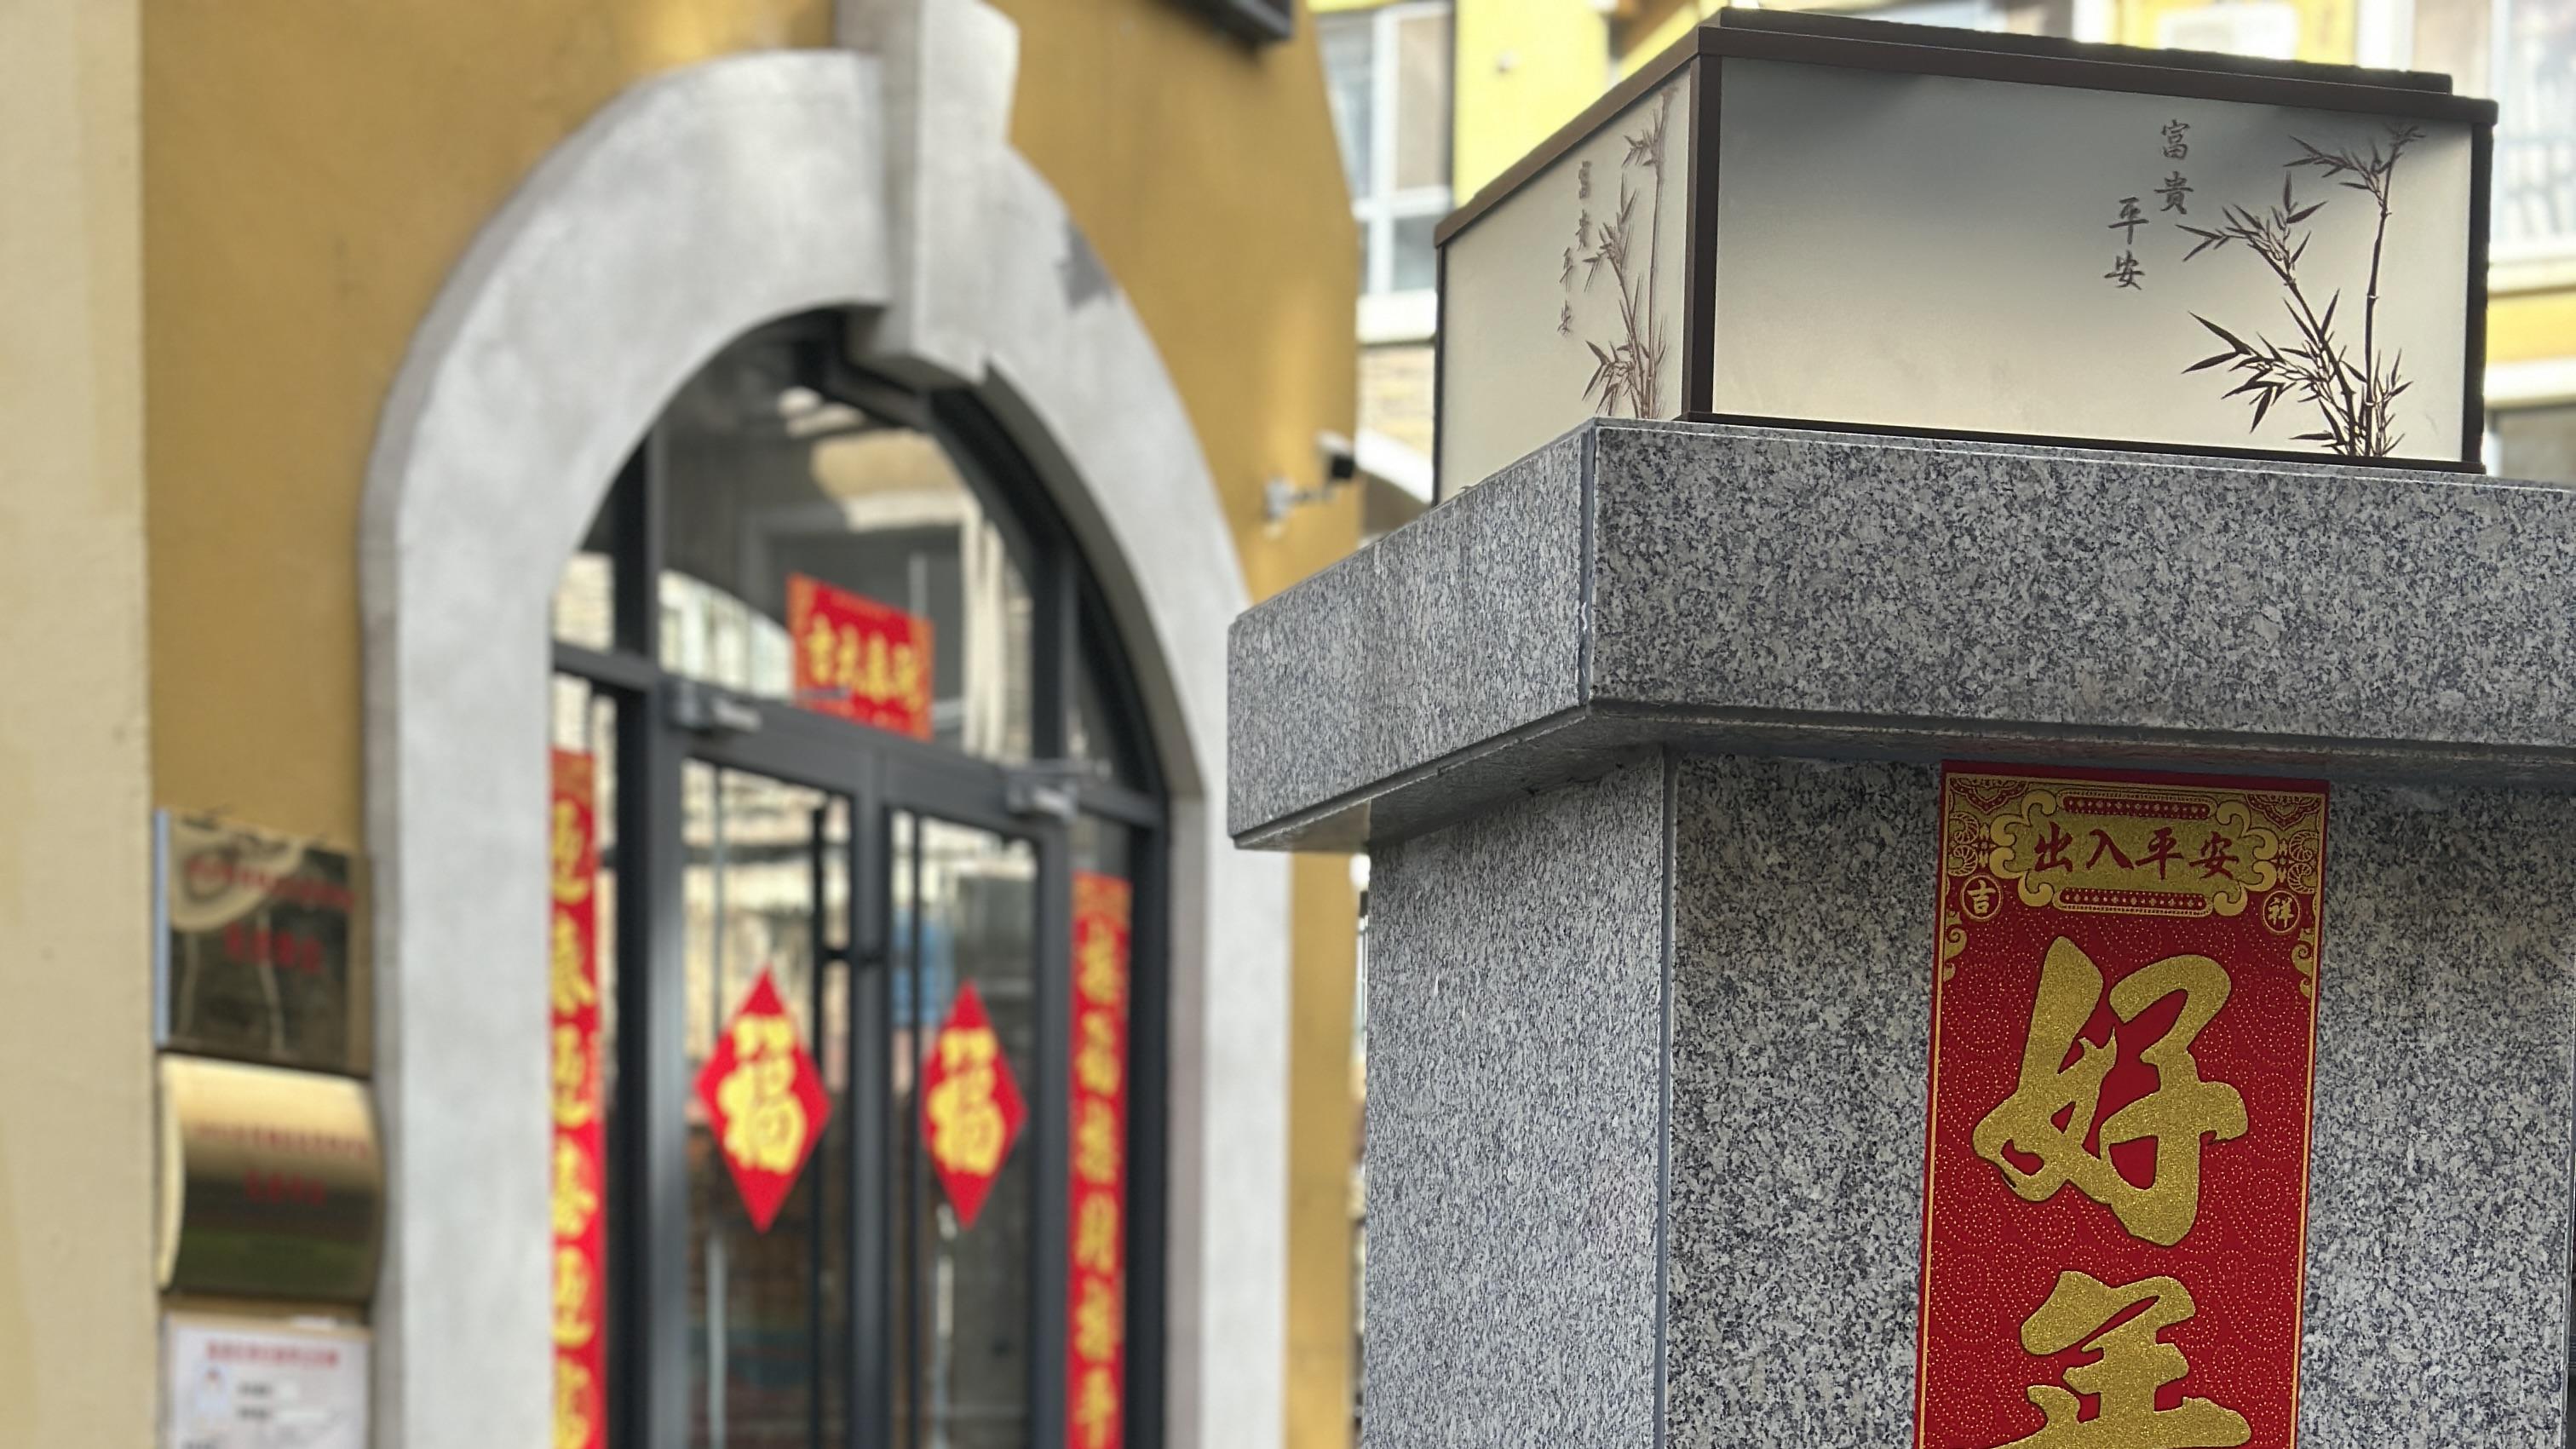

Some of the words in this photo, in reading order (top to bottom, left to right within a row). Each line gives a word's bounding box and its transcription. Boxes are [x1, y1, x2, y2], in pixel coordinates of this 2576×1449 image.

[2153, 118, 2194, 215] 富貴
[2104, 196, 2150, 290] 平安
[1966, 879, 1998, 915] 吉
[2033, 820, 2240, 881] 出入平安
[2267, 896, 2295, 926] 祥
[717, 1014, 808, 1176] 福
[926, 1028, 1006, 1177] 福
